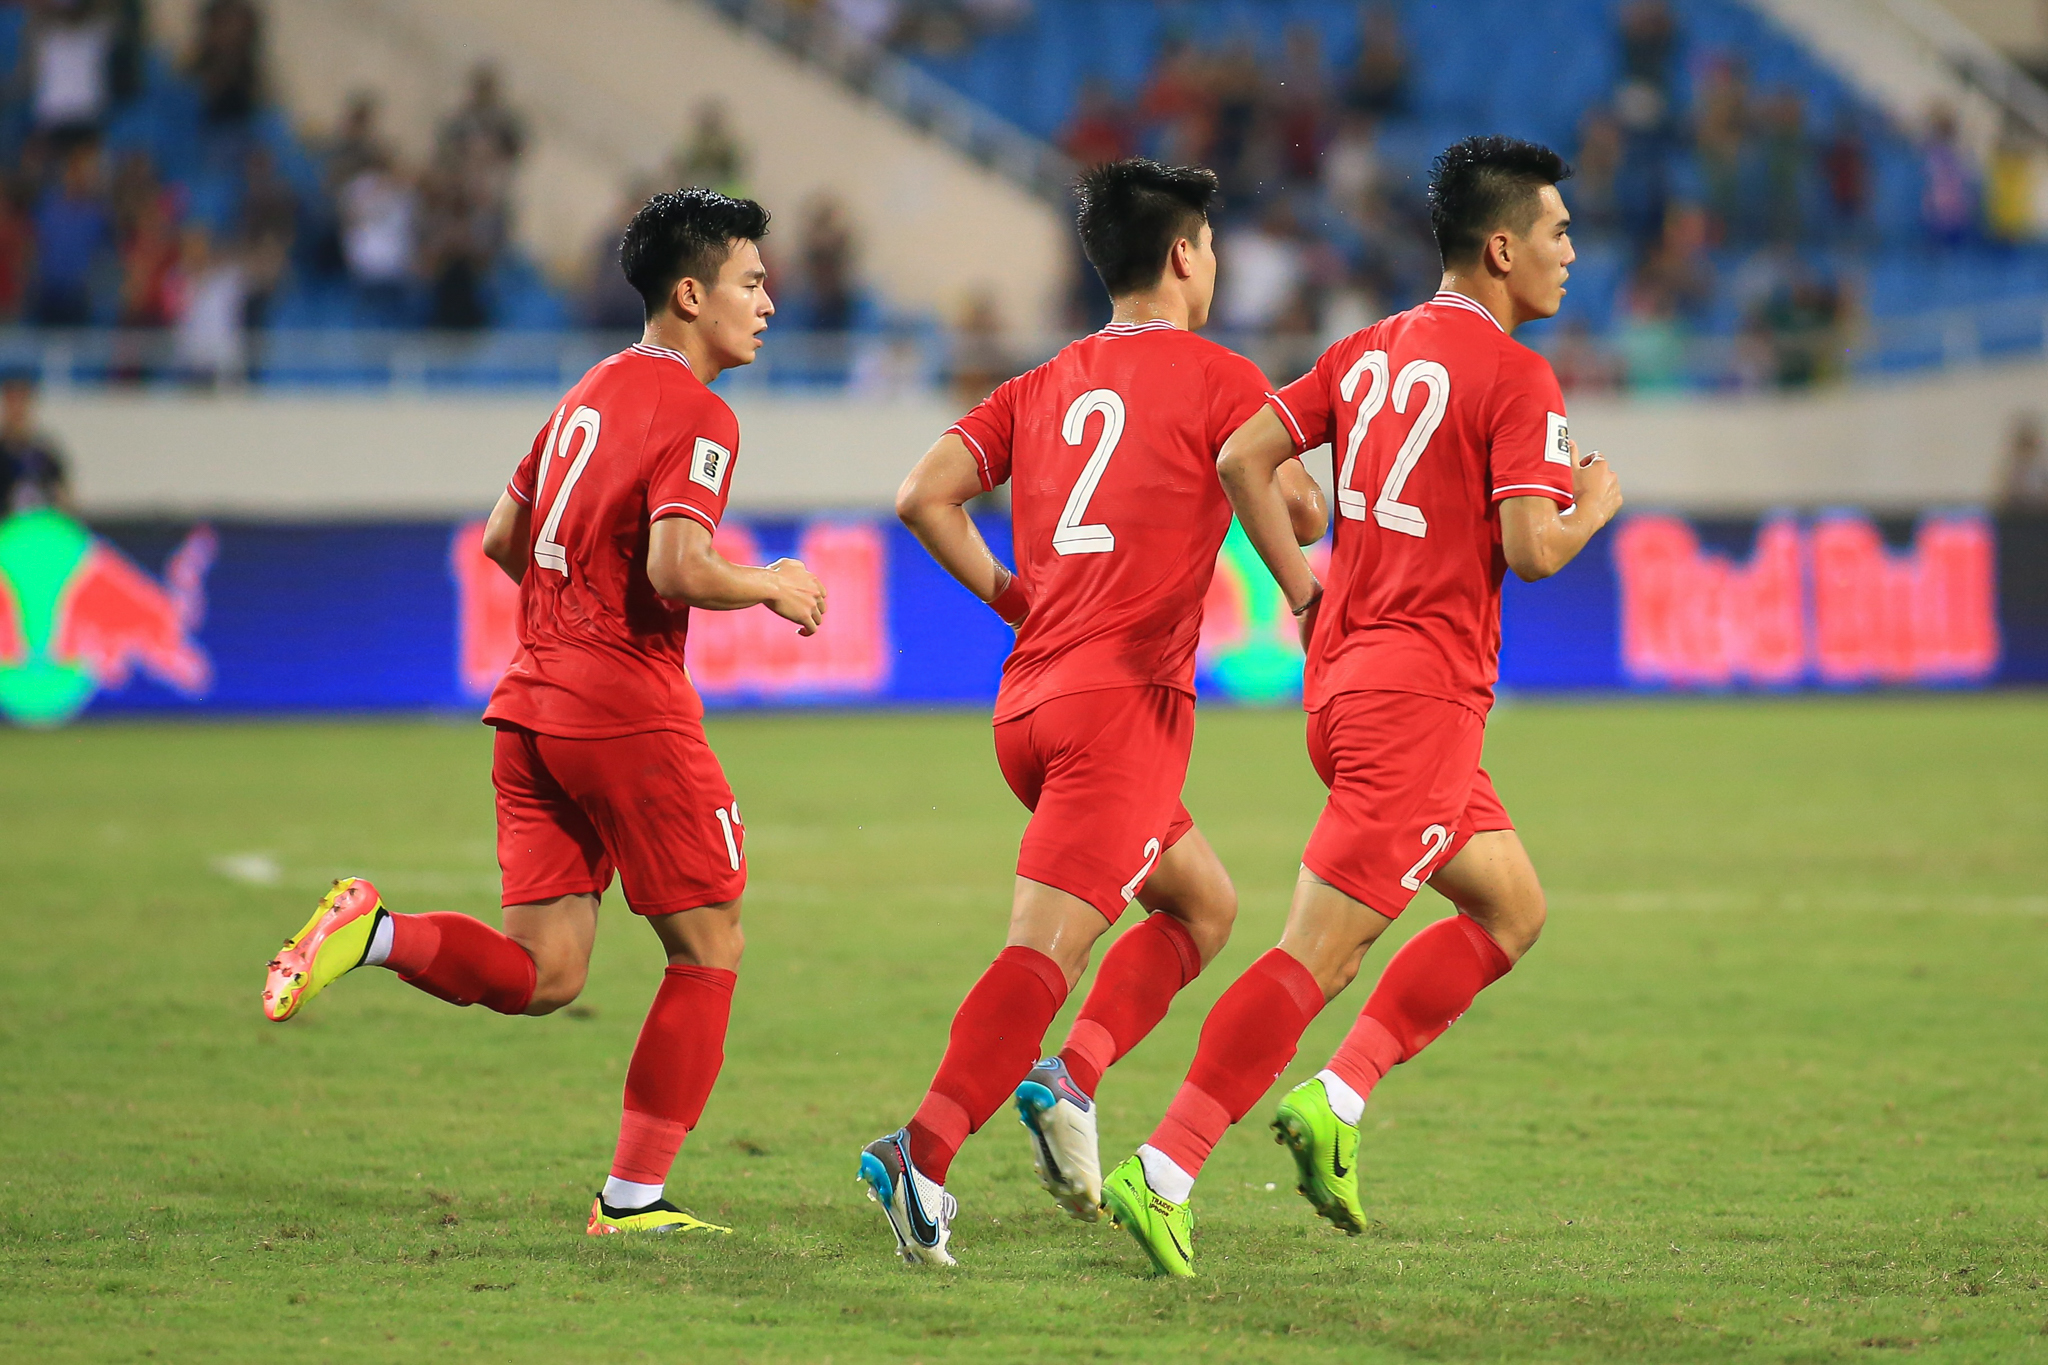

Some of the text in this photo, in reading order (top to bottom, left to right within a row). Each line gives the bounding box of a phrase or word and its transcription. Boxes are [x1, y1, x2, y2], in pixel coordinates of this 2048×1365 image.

[533, 403, 602, 578] 12
[1052, 388, 1126, 556] 2
[1337, 348, 1451, 539] 22
[1120, 836, 1161, 904] 2
